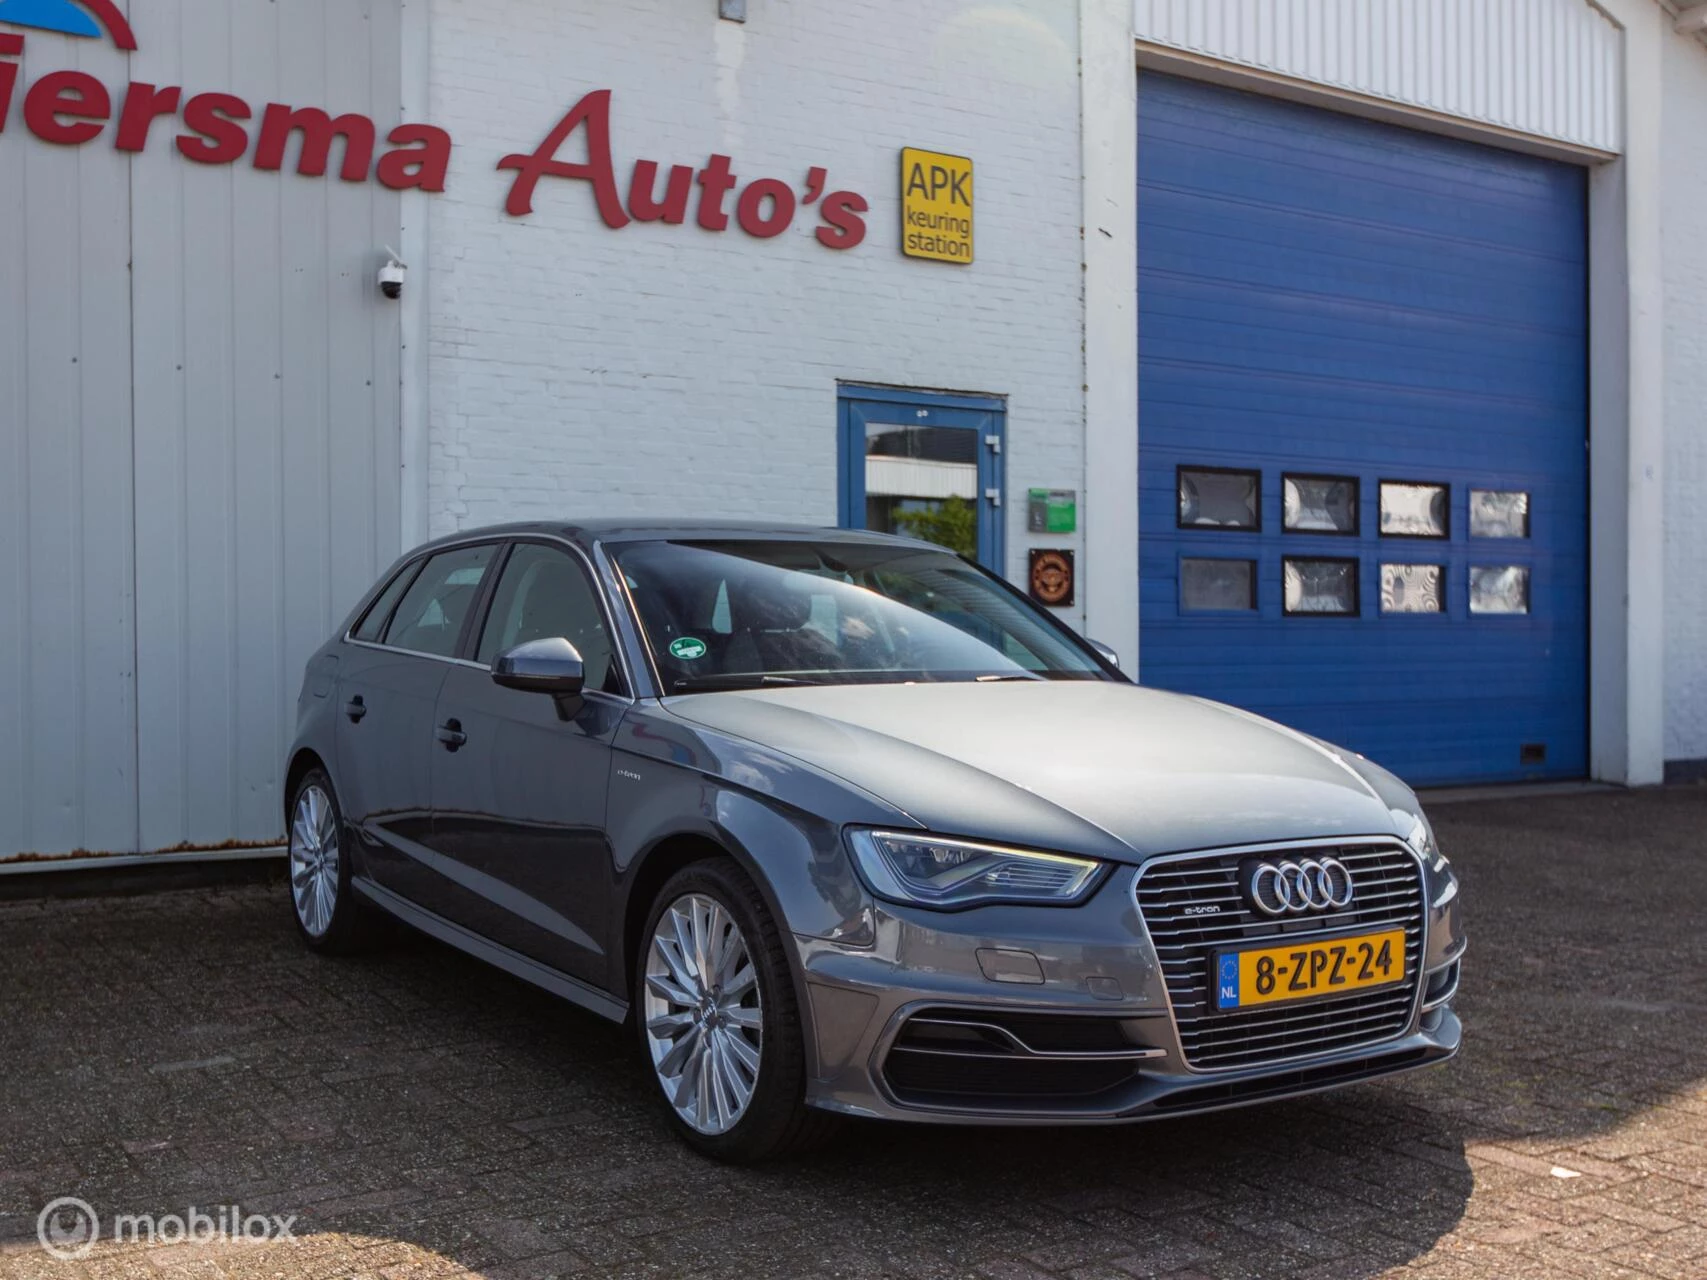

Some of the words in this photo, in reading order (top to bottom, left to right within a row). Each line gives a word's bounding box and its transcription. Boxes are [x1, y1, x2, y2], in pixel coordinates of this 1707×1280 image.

[496, 89, 870, 250] Auto's
[906, 162, 971, 207] APK
[906, 205, 970, 239] keuring
[907, 232, 970, 258] station
[1184, 905, 1221, 915] e-tron
[1255, 939, 1392, 996] 8-ZPZ-24
[1221, 987, 1237, 999] NL
